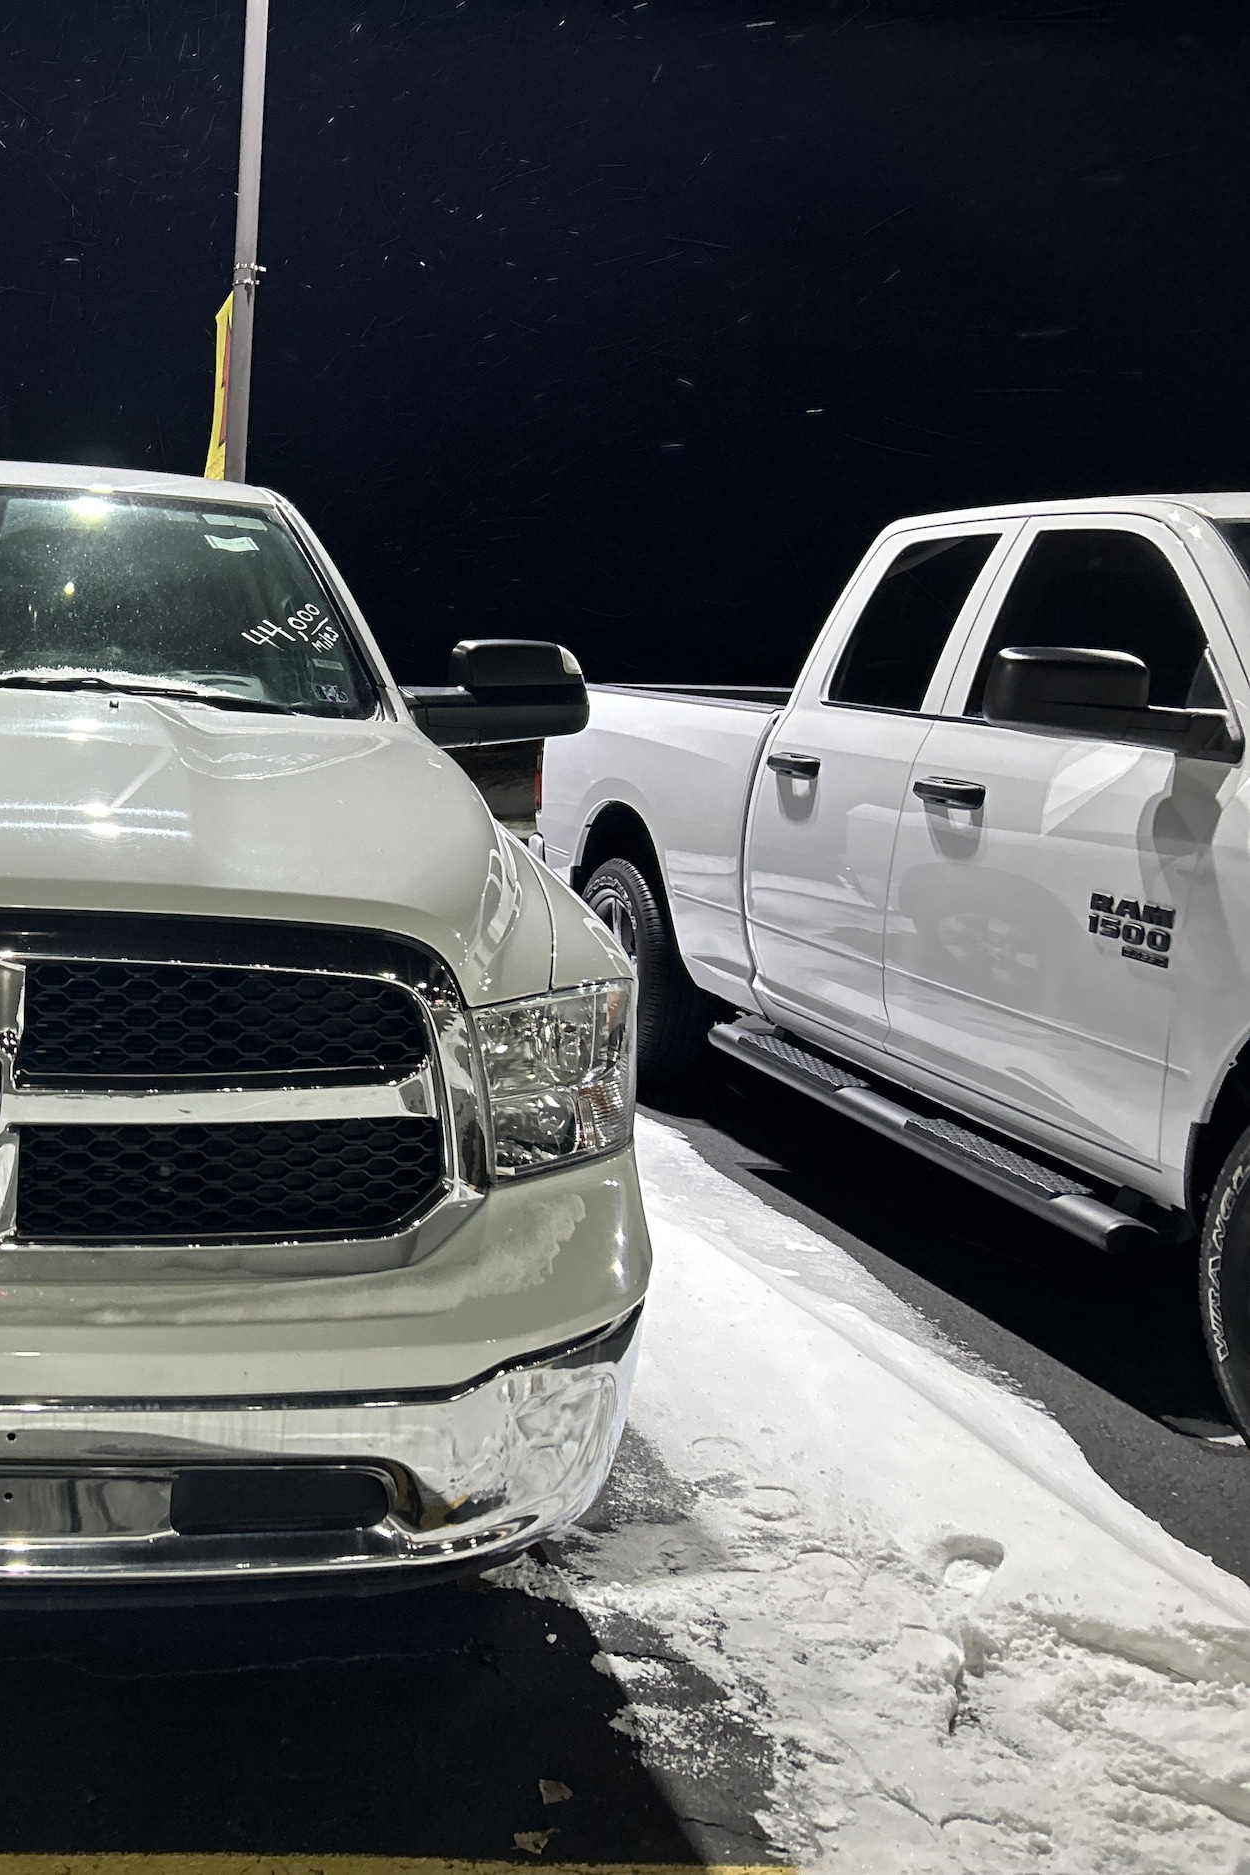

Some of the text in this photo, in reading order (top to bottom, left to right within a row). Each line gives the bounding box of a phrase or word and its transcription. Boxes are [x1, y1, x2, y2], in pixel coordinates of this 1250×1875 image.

[241, 602, 321, 652] 44,000
[1090, 889, 1176, 930] RAM
[1088, 912, 1172, 953] 1500
